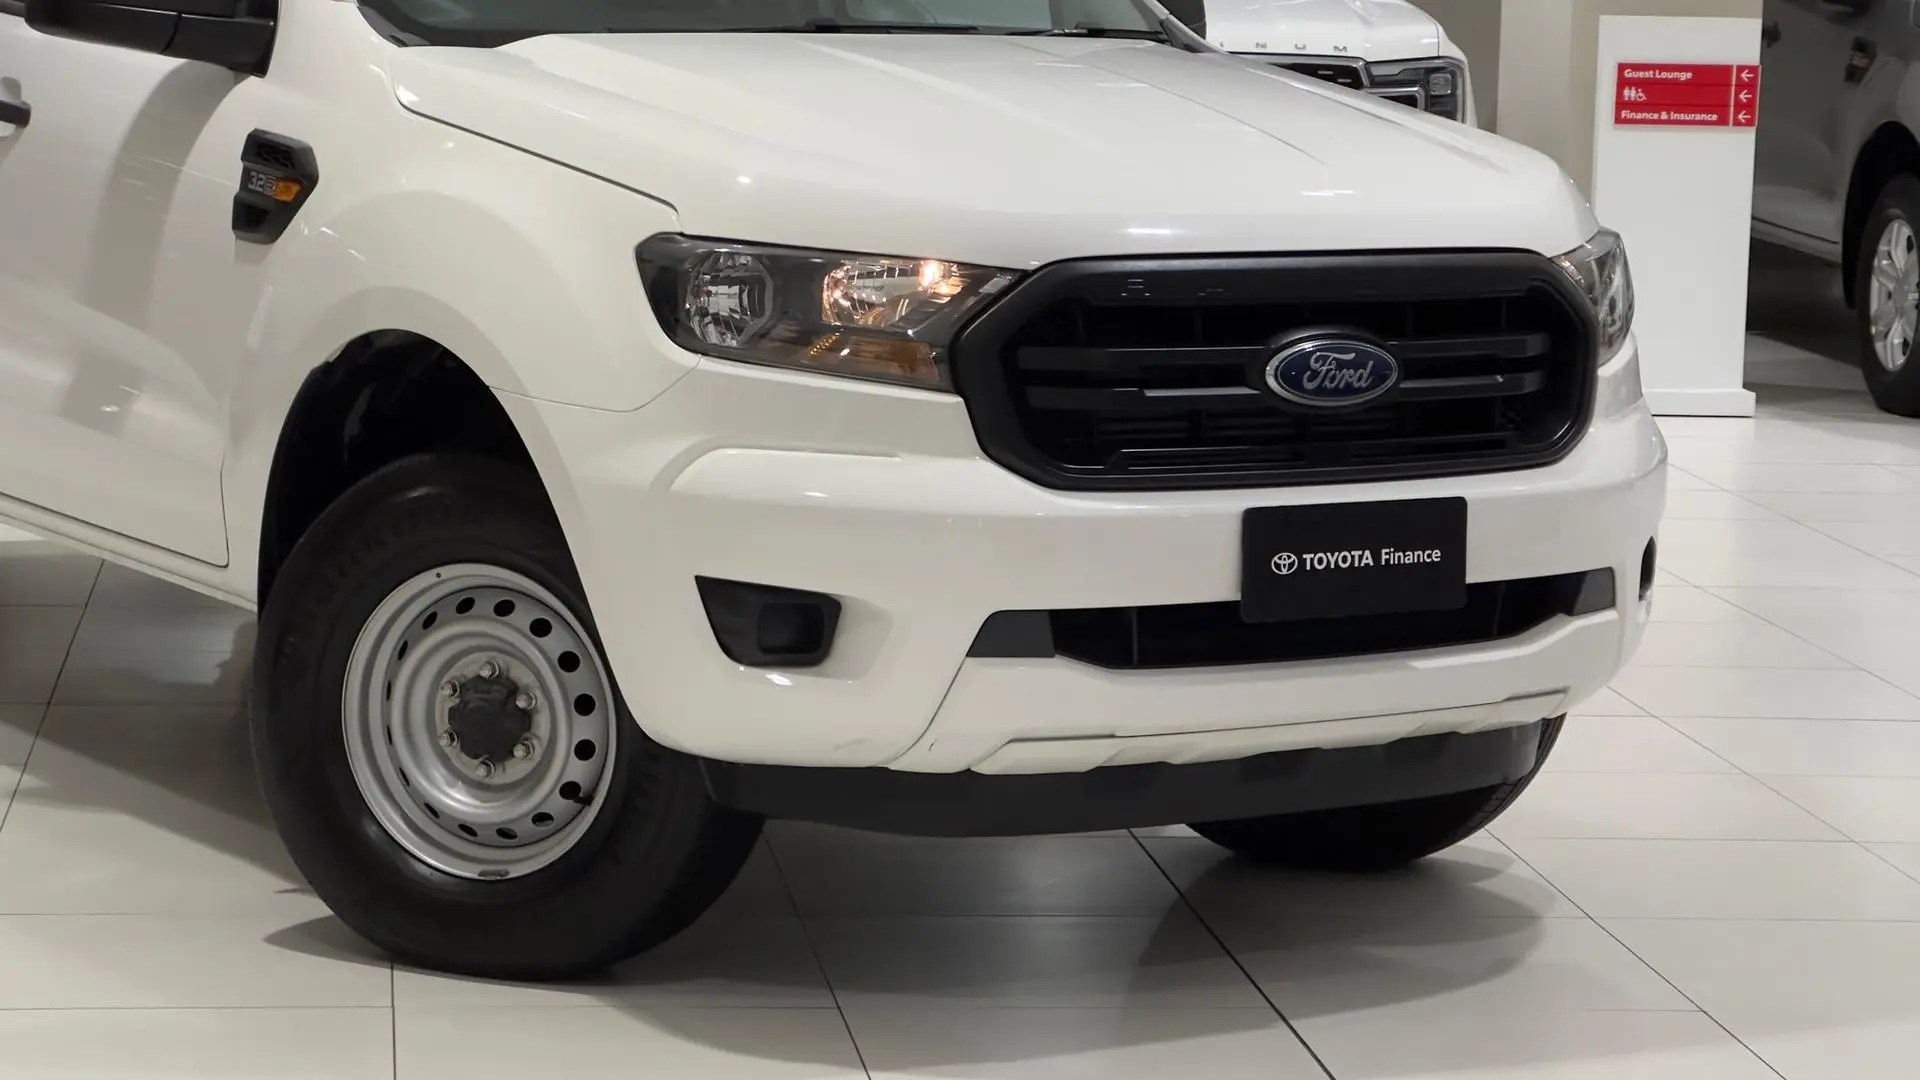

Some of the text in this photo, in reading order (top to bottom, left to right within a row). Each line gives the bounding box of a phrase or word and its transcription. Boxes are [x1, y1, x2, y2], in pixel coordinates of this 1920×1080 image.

[1624, 69, 1693, 80] Guest Lounge
[1621, 110, 1718, 121] Finance & Insurance
[1302, 351, 1374, 390] Ford
[1302, 548, 1441, 571] TOYOTA Finance
